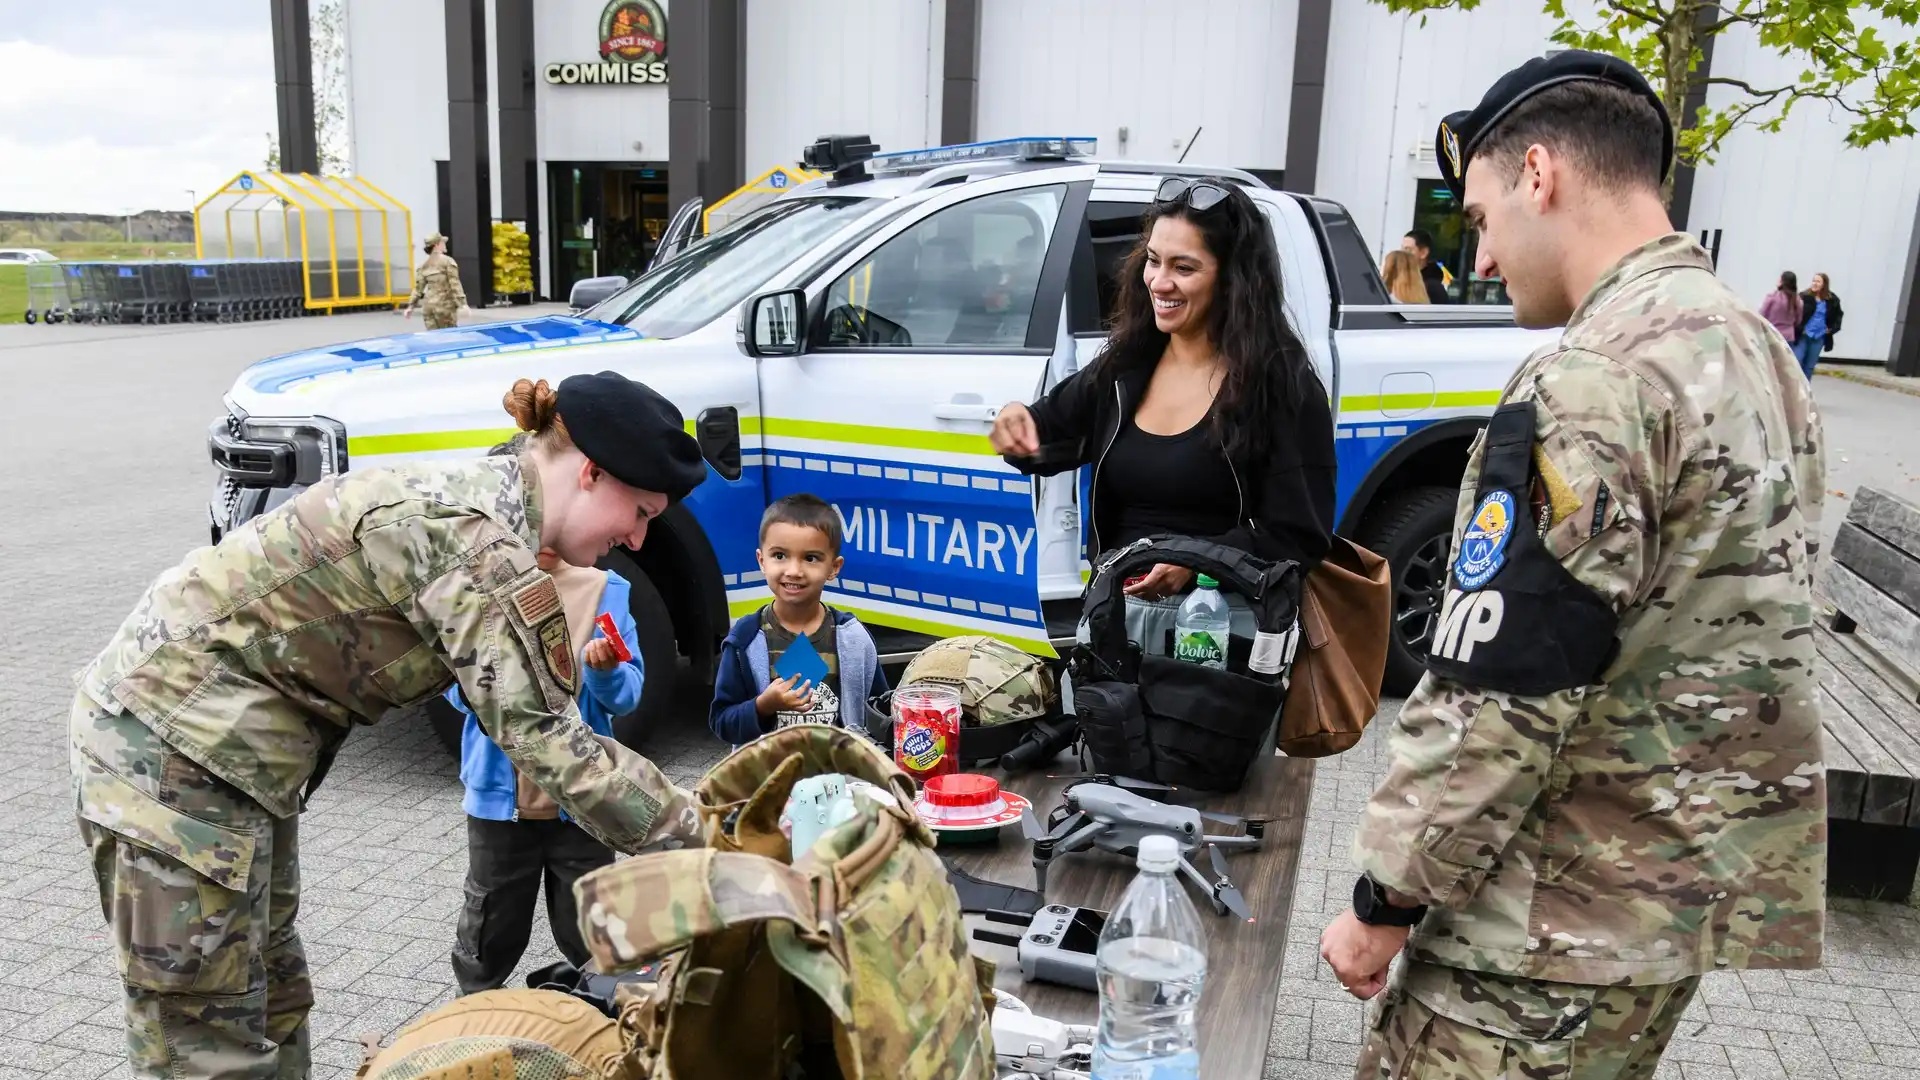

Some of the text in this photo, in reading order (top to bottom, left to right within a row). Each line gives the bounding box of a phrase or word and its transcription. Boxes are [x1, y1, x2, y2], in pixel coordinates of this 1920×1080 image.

[544, 62, 669, 84] COMMISS
[1483, 491, 1508, 507] NATO
[831, 503, 1036, 576] MILITARY
[1462, 557, 1491, 575] AWACS
[1431, 588, 1505, 663] MP
[1179, 642, 1220, 659] Volvic
[904, 734, 924, 751] swirl
[911, 740, 932, 755] pops
